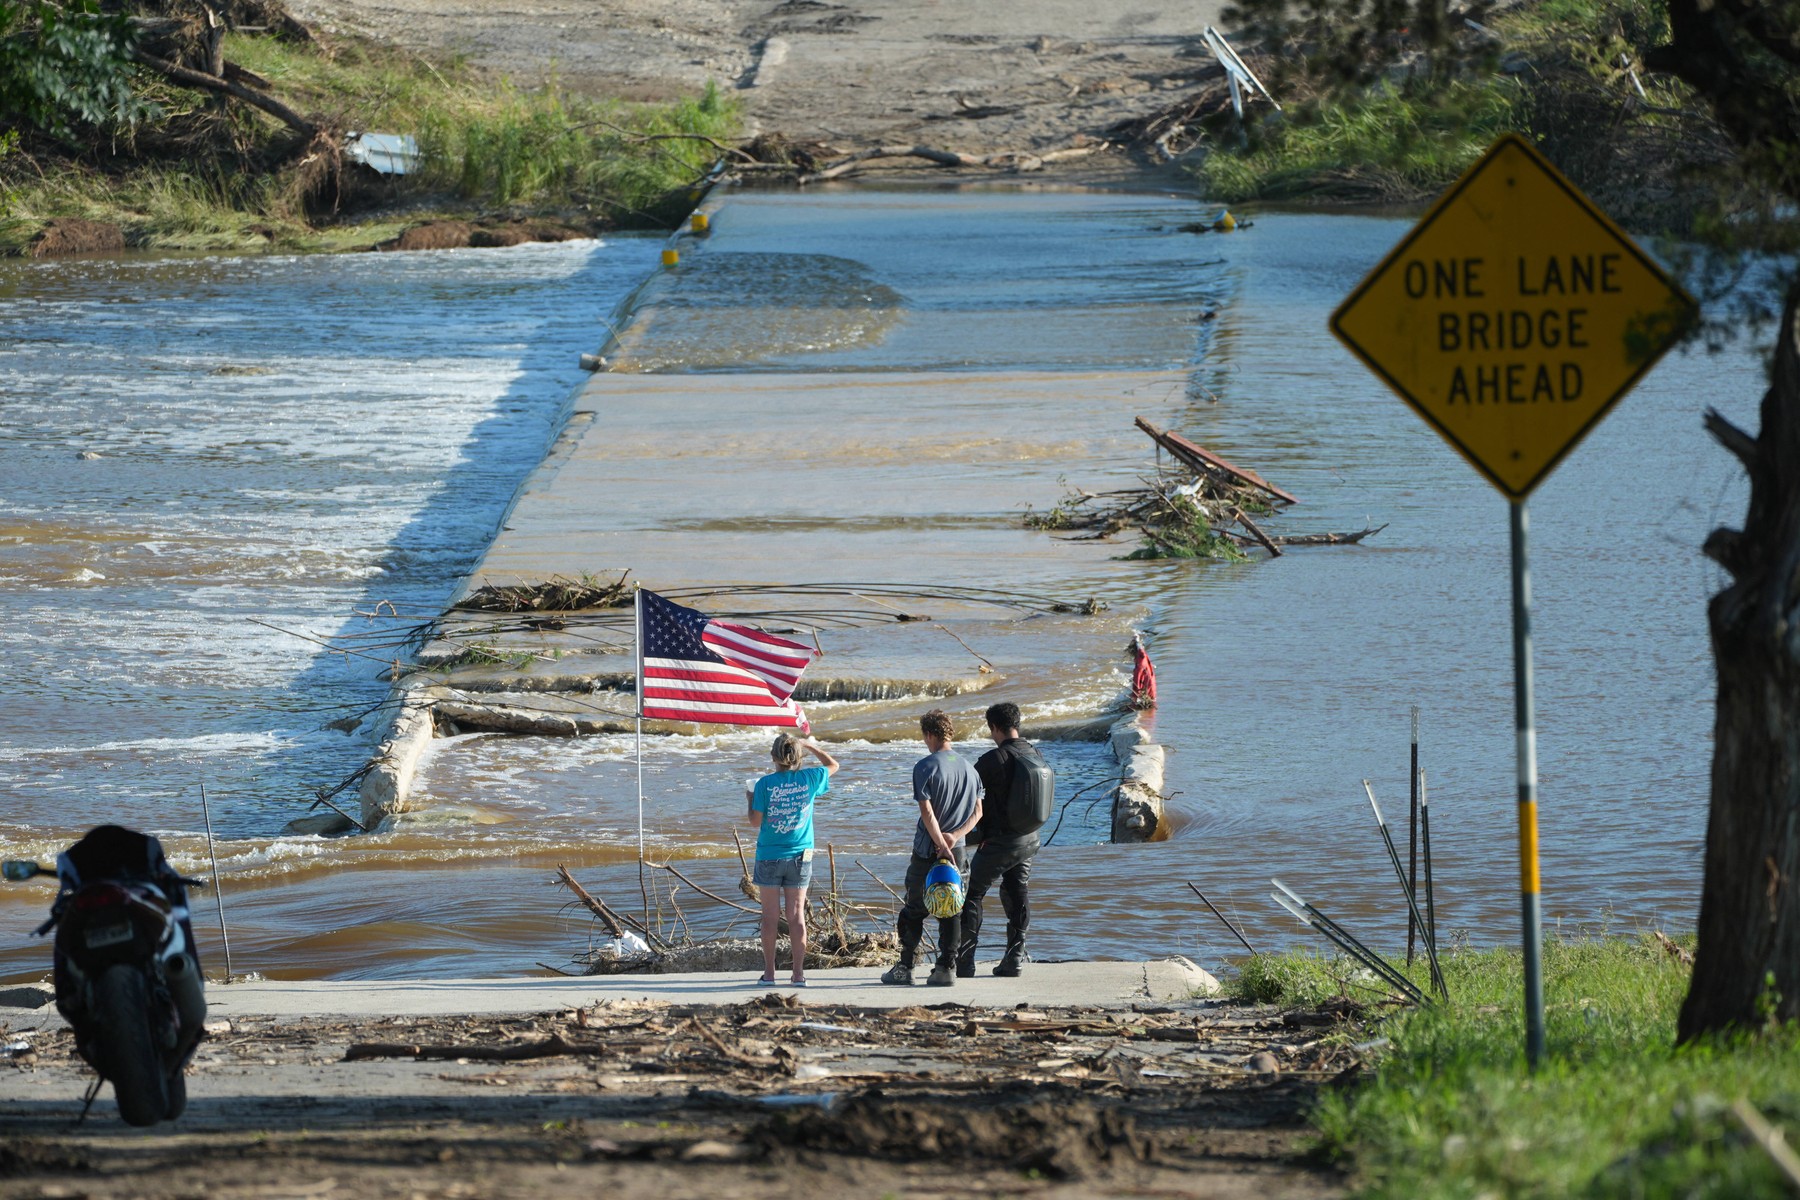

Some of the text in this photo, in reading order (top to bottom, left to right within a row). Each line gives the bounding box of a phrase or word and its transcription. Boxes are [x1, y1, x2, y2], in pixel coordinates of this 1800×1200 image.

[1404, 253, 1622, 299] ONE LANE
[1439, 309, 1589, 352] BRIDGE
[1448, 363, 1584, 405] AHEAD
[767, 785, 808, 798] Remember
